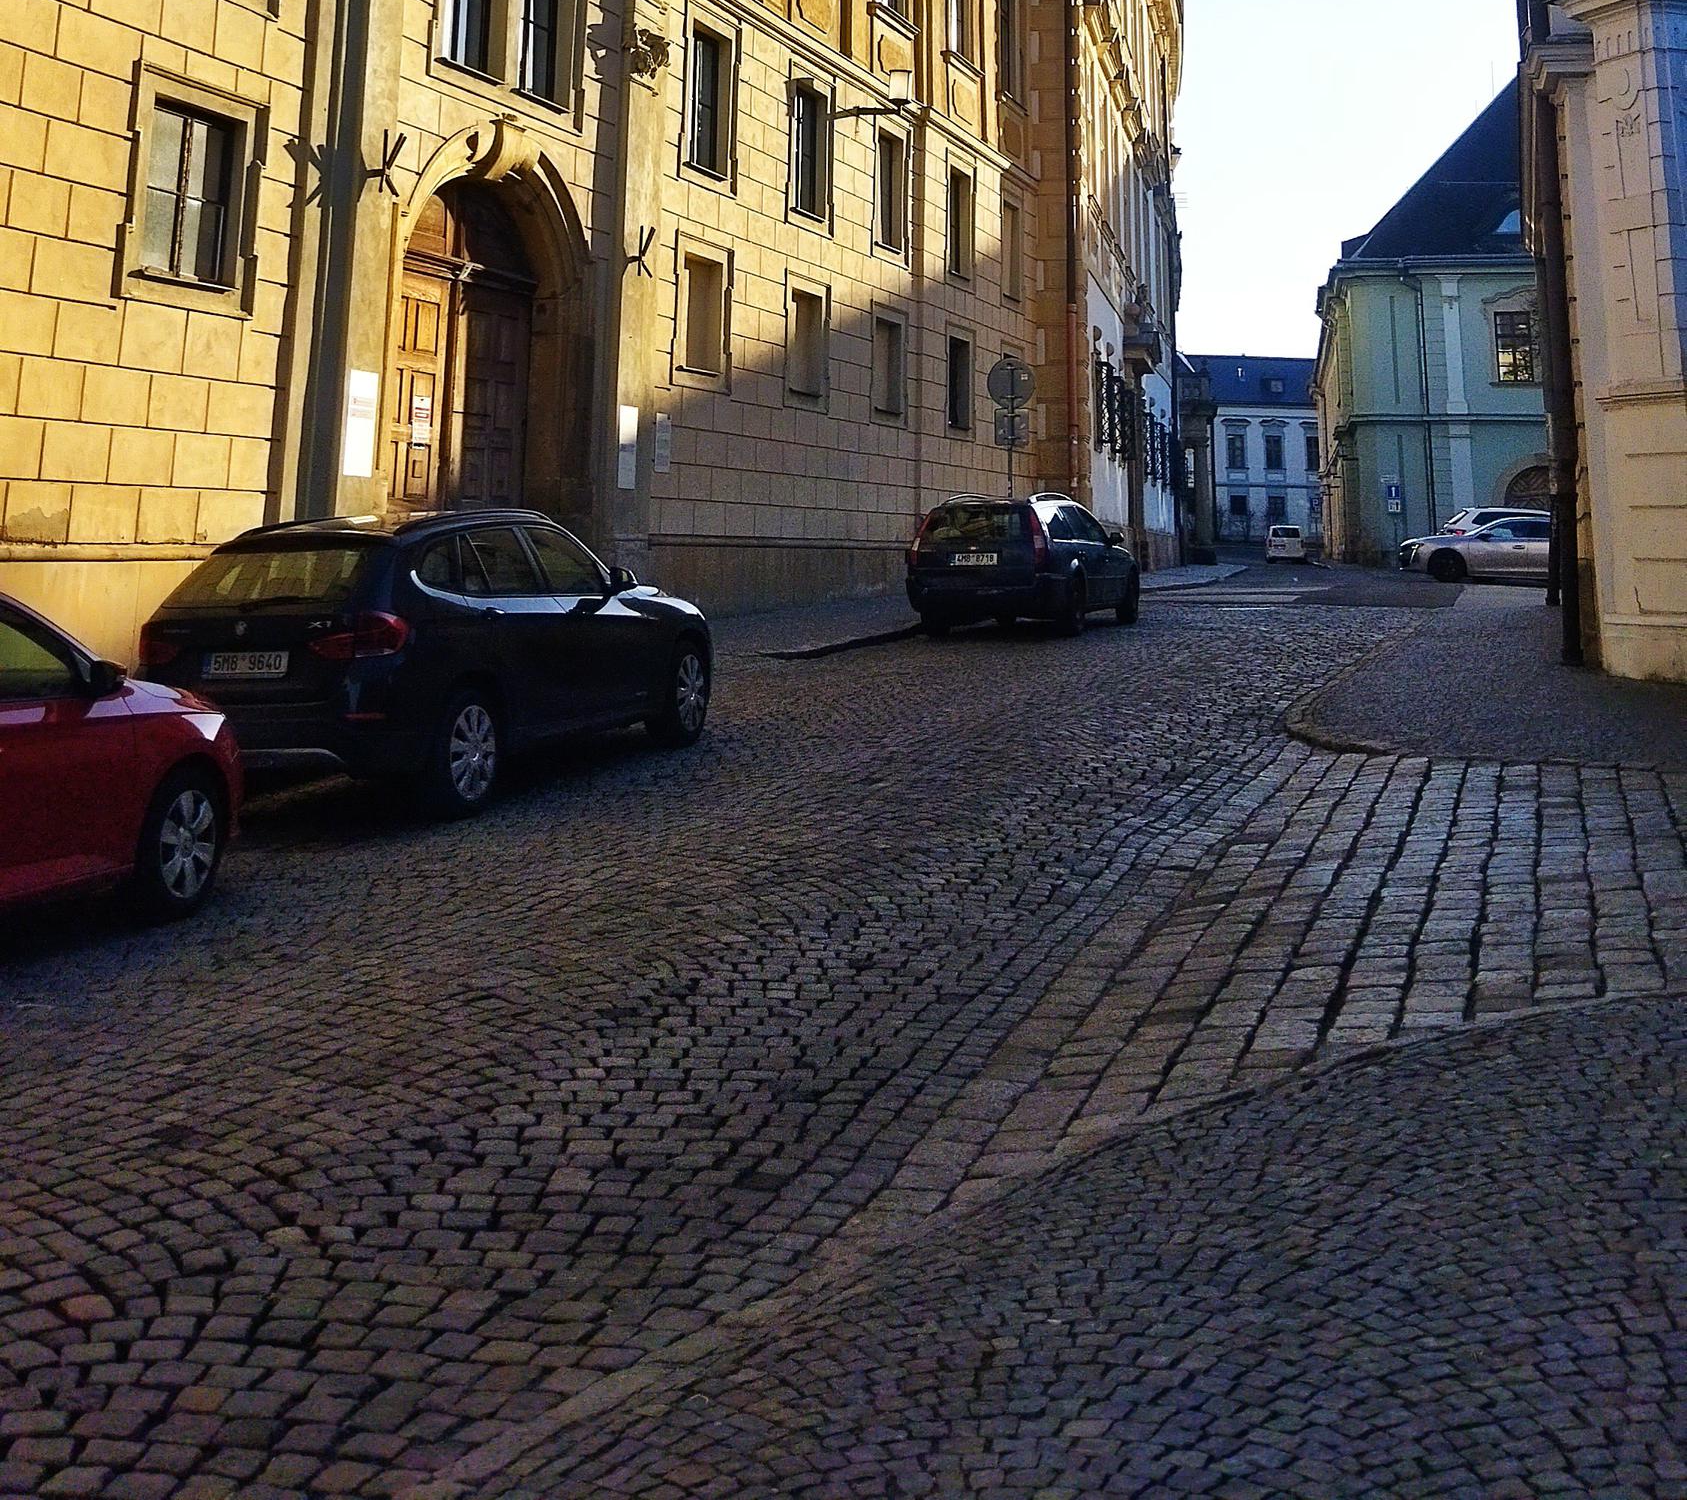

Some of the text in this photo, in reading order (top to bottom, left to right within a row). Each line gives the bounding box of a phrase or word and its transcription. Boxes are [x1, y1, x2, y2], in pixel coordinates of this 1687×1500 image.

[307, 620, 333, 629] X1
[213, 653, 282, 672] 5M8 9640
